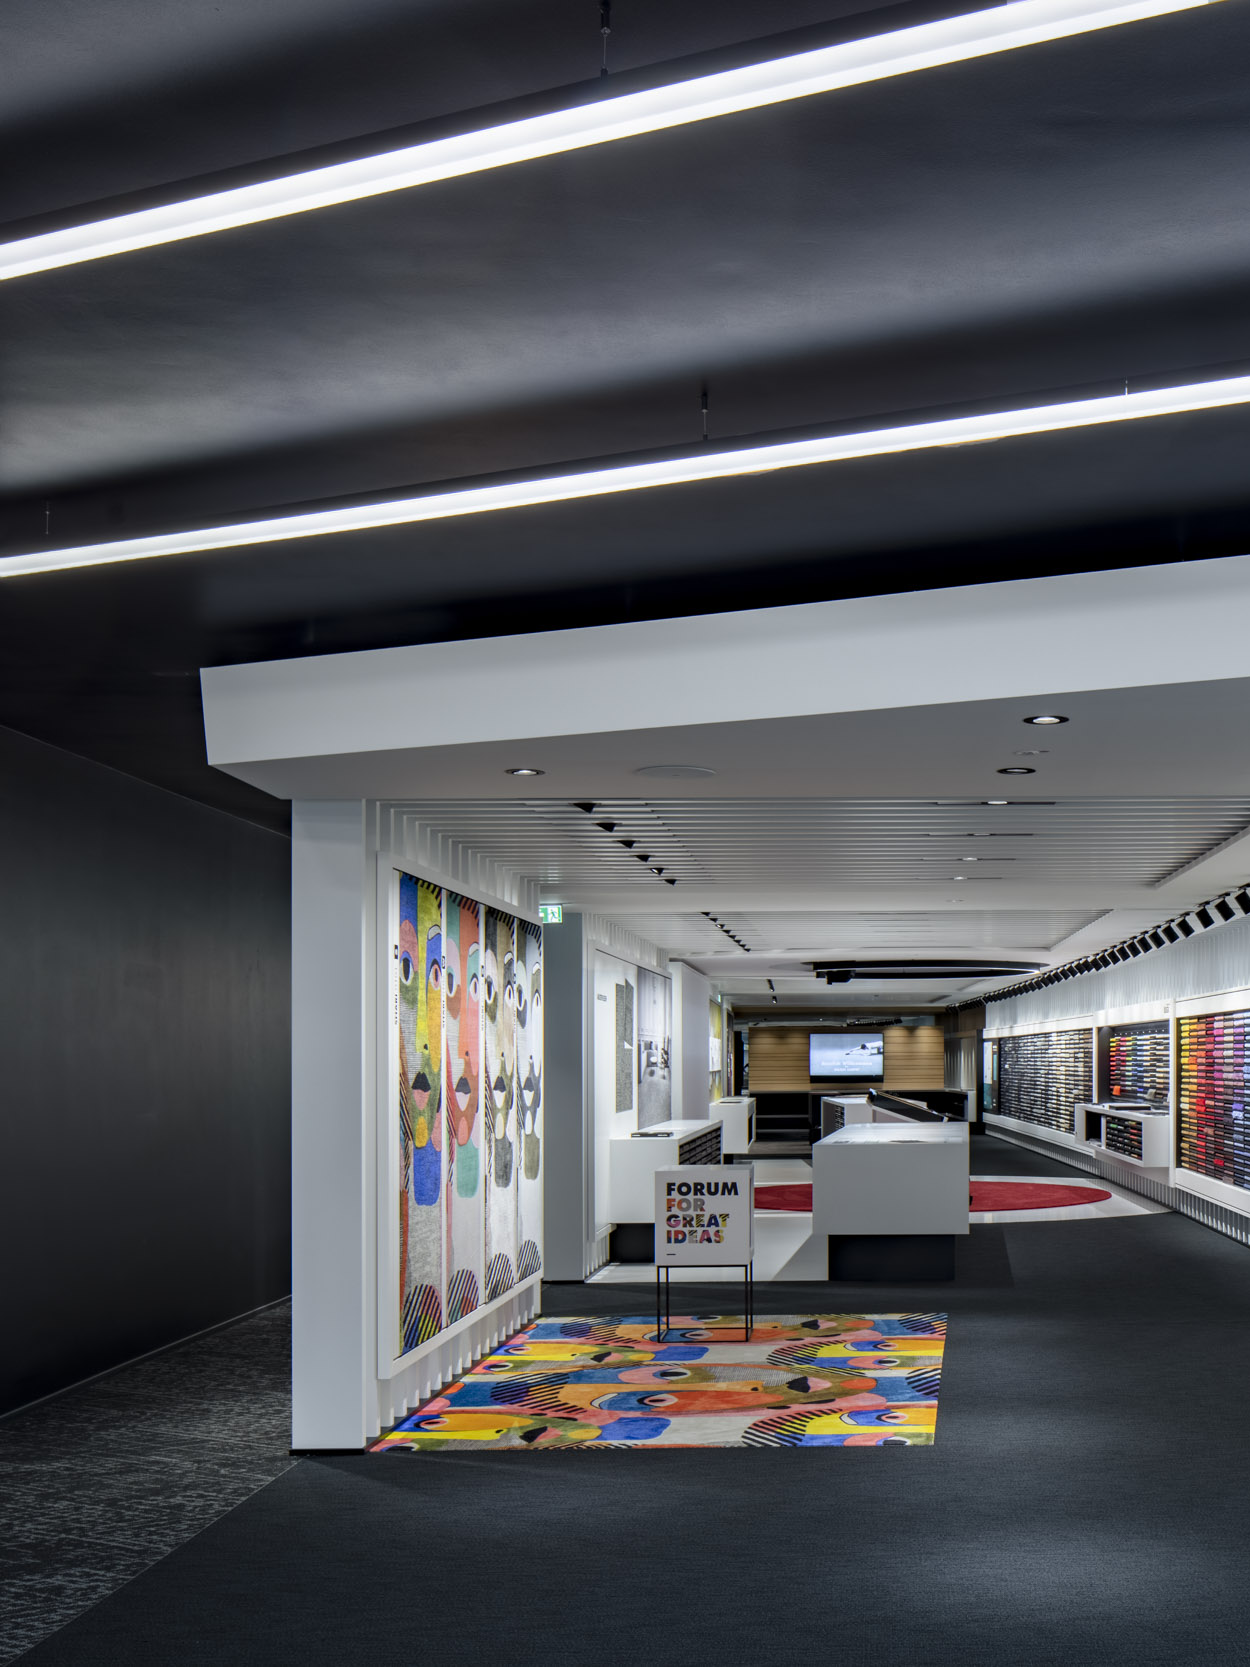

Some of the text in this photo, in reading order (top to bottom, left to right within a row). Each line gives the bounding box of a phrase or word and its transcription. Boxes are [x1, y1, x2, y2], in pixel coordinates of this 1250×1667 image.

[666, 1182, 739, 1196] FORUM
[666, 1198, 706, 1212] FOR
[666, 1213, 730, 1228] GREAT
[666, 1229, 725, 1244] IDEAS
